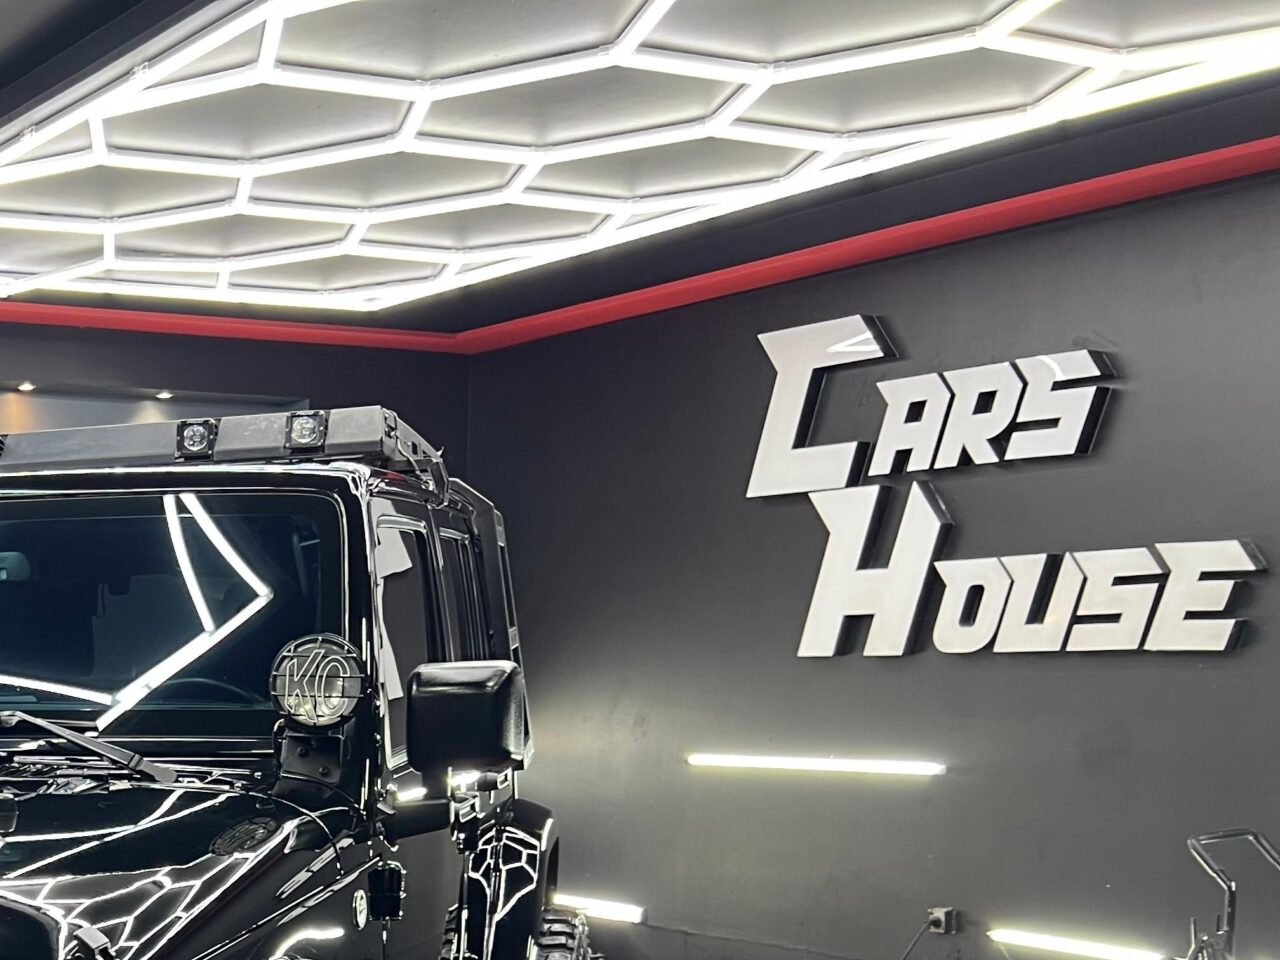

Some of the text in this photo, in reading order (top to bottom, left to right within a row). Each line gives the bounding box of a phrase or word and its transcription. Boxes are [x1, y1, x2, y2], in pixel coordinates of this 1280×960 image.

[746, 313, 1113, 498] CARS
[797, 481, 1265, 657] HOUSE
[284, 649, 350, 722] KC
